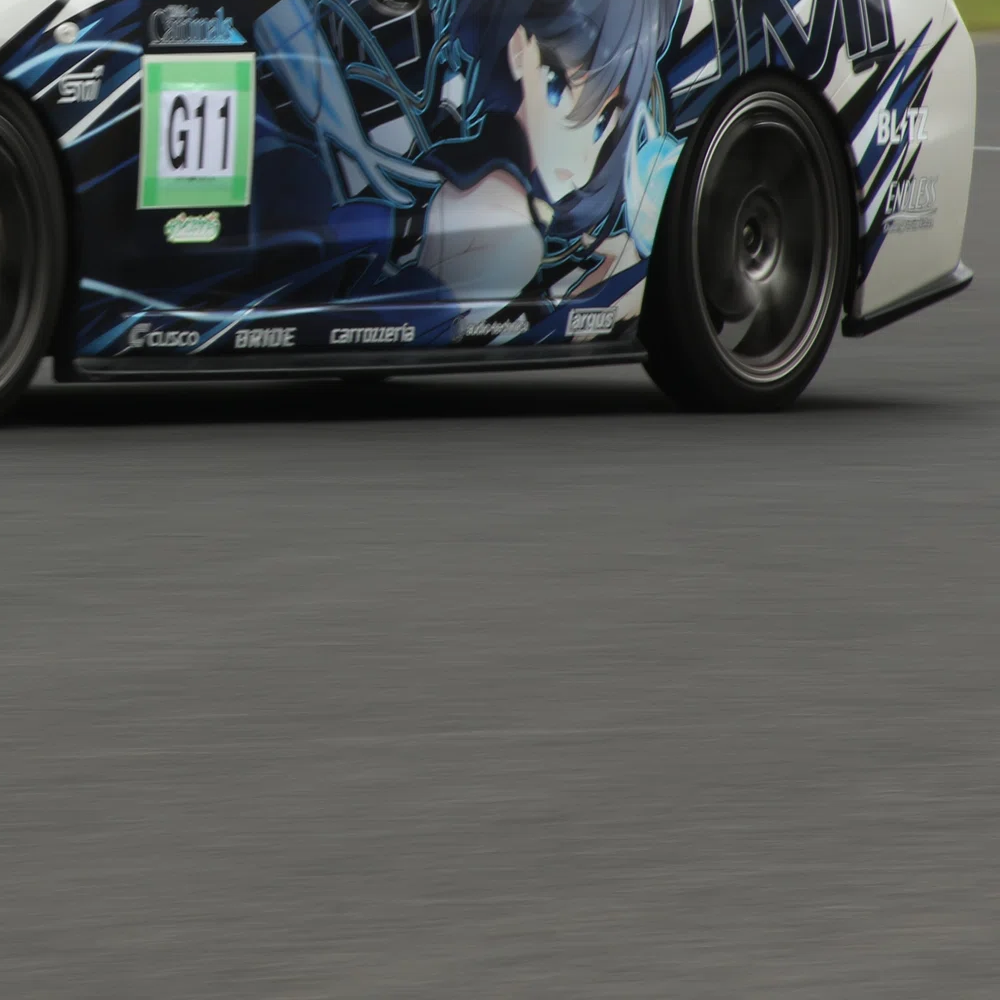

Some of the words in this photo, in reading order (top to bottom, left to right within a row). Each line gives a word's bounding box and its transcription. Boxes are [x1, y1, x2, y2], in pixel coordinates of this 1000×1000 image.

[167, 95, 231, 170] G11
[876, 106, 928, 145] BLITZ
[235, 327, 297, 348] BRIDE
[330, 323, 416, 344] carrozzeria
